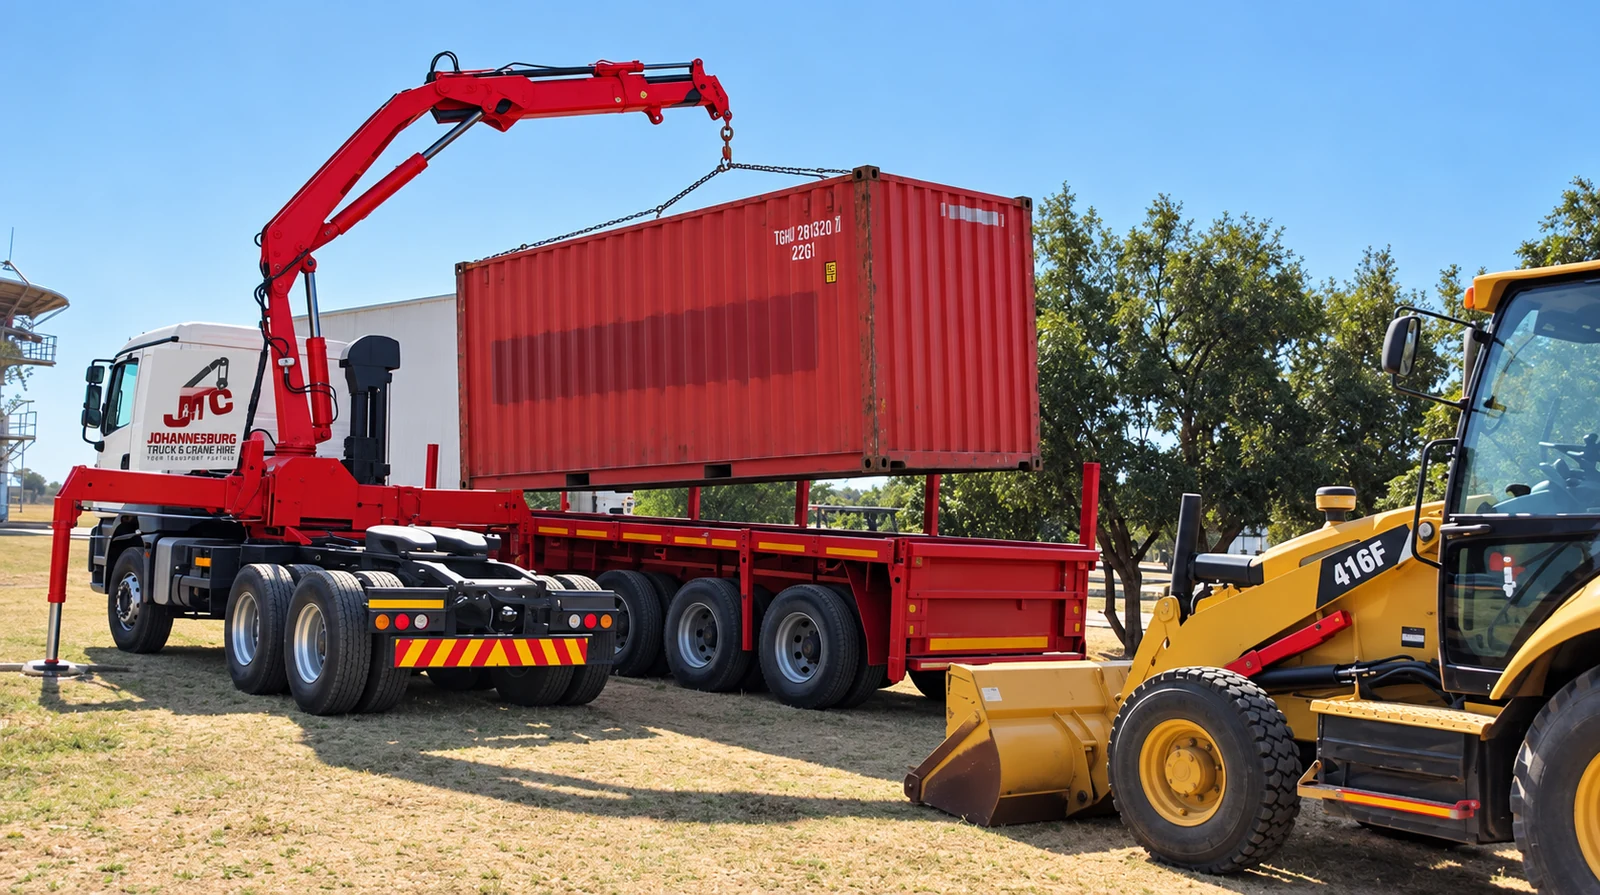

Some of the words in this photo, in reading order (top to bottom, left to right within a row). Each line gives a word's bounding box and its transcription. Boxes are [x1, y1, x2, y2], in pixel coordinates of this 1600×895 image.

[774, 226, 795, 246] TGHU
[797, 219, 832, 241] 281320
[792, 242, 815, 261] 22G1
[147, 432, 237, 445] JOHANNESBURG
[147, 445, 177, 455] TRUCK
[178, 445, 184, 455] &
[185, 445, 215, 455] CRANE
[216, 445, 236, 455] HIRE
[1334, 540, 1386, 586] 416F
